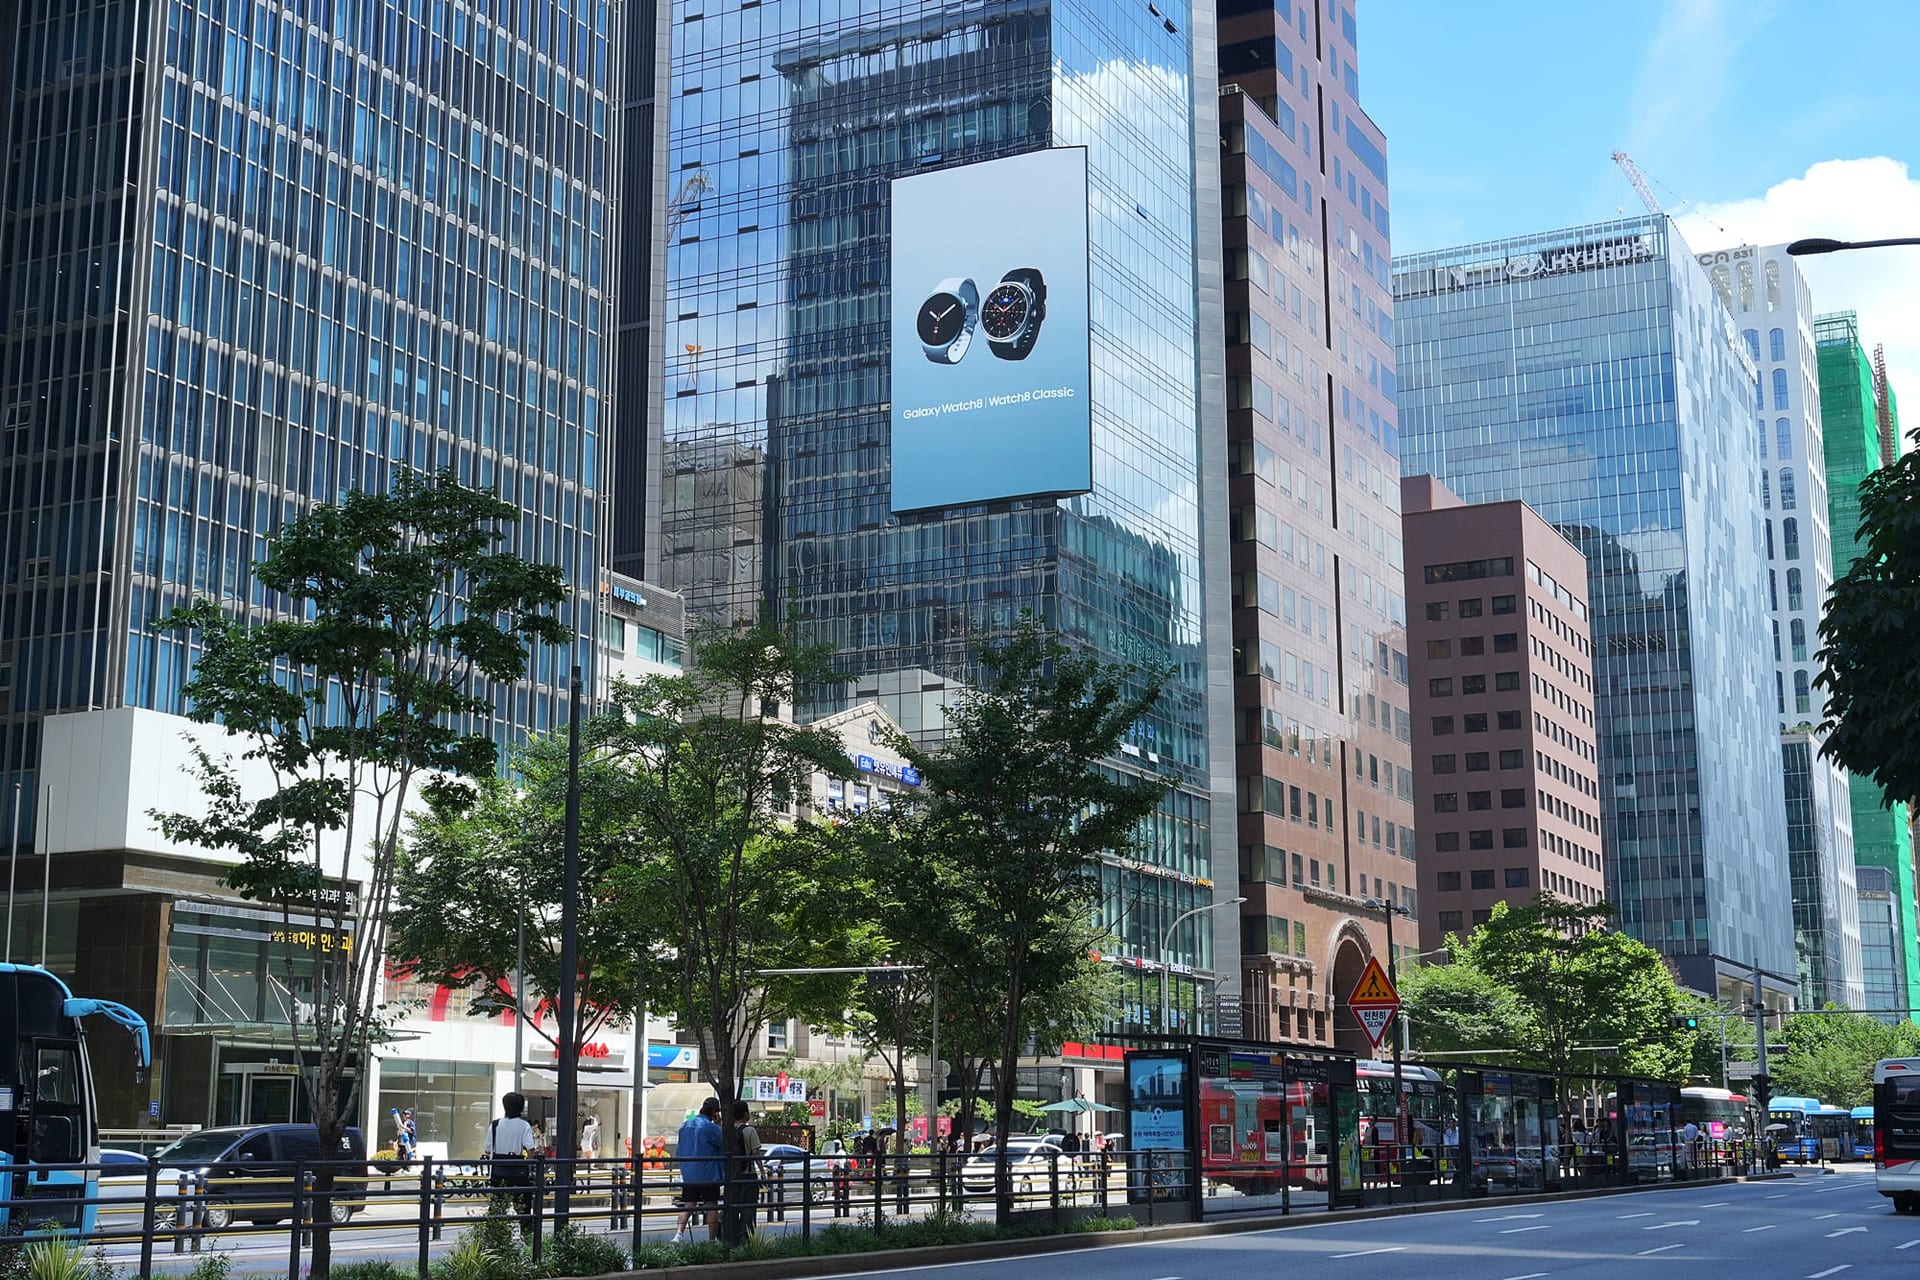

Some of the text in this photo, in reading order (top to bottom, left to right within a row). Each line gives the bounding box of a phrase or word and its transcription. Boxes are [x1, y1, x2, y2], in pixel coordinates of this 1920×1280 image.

[1551, 241, 1654, 272] HYUNDAI
[1733, 249, 1753, 260] 831
[903, 387, 1075, 420] Galaxy Watch8 Watch8 Classic
[1364, 1010, 1386, 1020] 천천히
